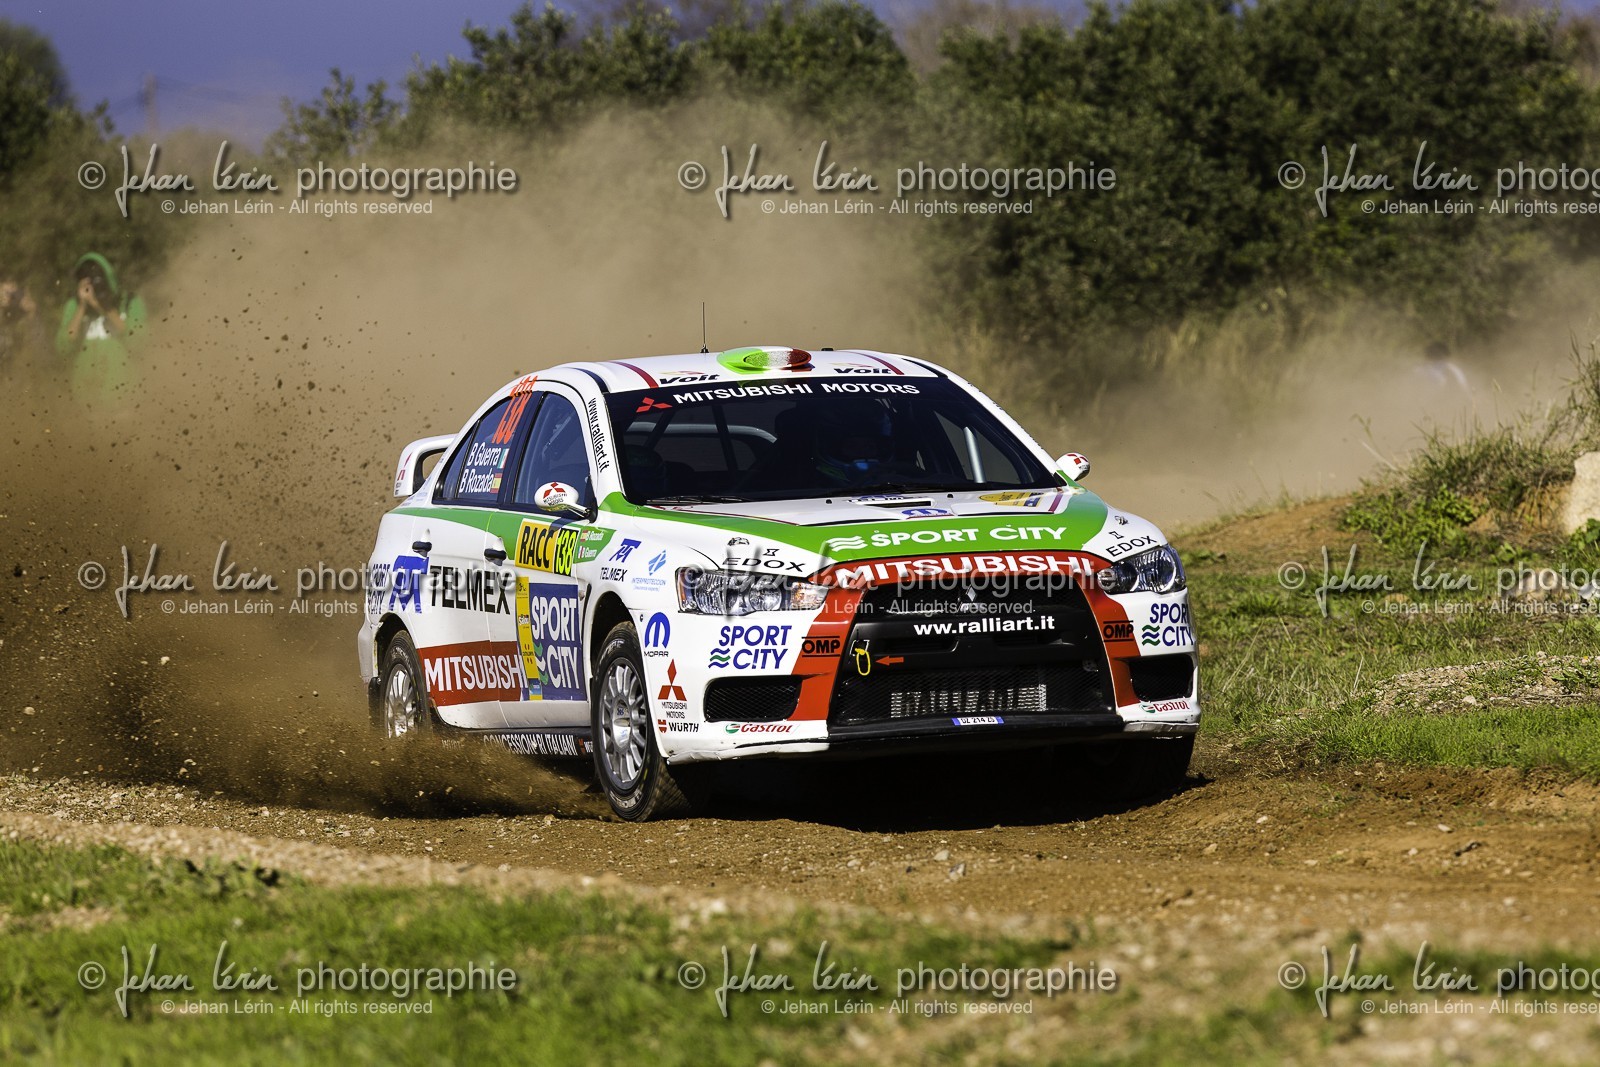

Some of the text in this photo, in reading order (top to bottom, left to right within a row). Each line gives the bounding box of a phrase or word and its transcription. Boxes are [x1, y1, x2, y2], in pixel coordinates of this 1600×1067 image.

[673, 383, 920, 405] MITSUBISHI MOTORS
[588, 397, 609, 473] www.ralliart.it
[467, 442, 501, 466] B Guerra
[465, 468, 494, 493] Rozada
[870, 526, 1067, 547] SPORT CITY
[1106, 536, 1157, 557] EDOX
[519, 525, 577, 575] RACC 138
[600, 567, 628, 582] TELMEX
[722, 557, 806, 573] EDOX
[834, 555, 1093, 589] MITSUBISHI
[430, 565, 510, 615] TELMEX
[531, 595, 577, 641] SPORT
[914, 616, 1055, 636] ww.ralliart.it
[718, 625, 792, 647] SPORT
[1103, 623, 1134, 639] OMP
[1162, 626, 1195, 647] CITY
[802, 639, 840, 655] OMP
[424, 655, 529, 692] MITSUBISHI
[547, 645, 580, 689] CITY
[661, 701, 688, 710] MITSUBISHI
[666, 711, 685, 719] MOTORS
[1154, 700, 1190, 712] Castrol
[669, 721, 699, 733] WÜRTH
[740, 723, 793, 734] Castrol
